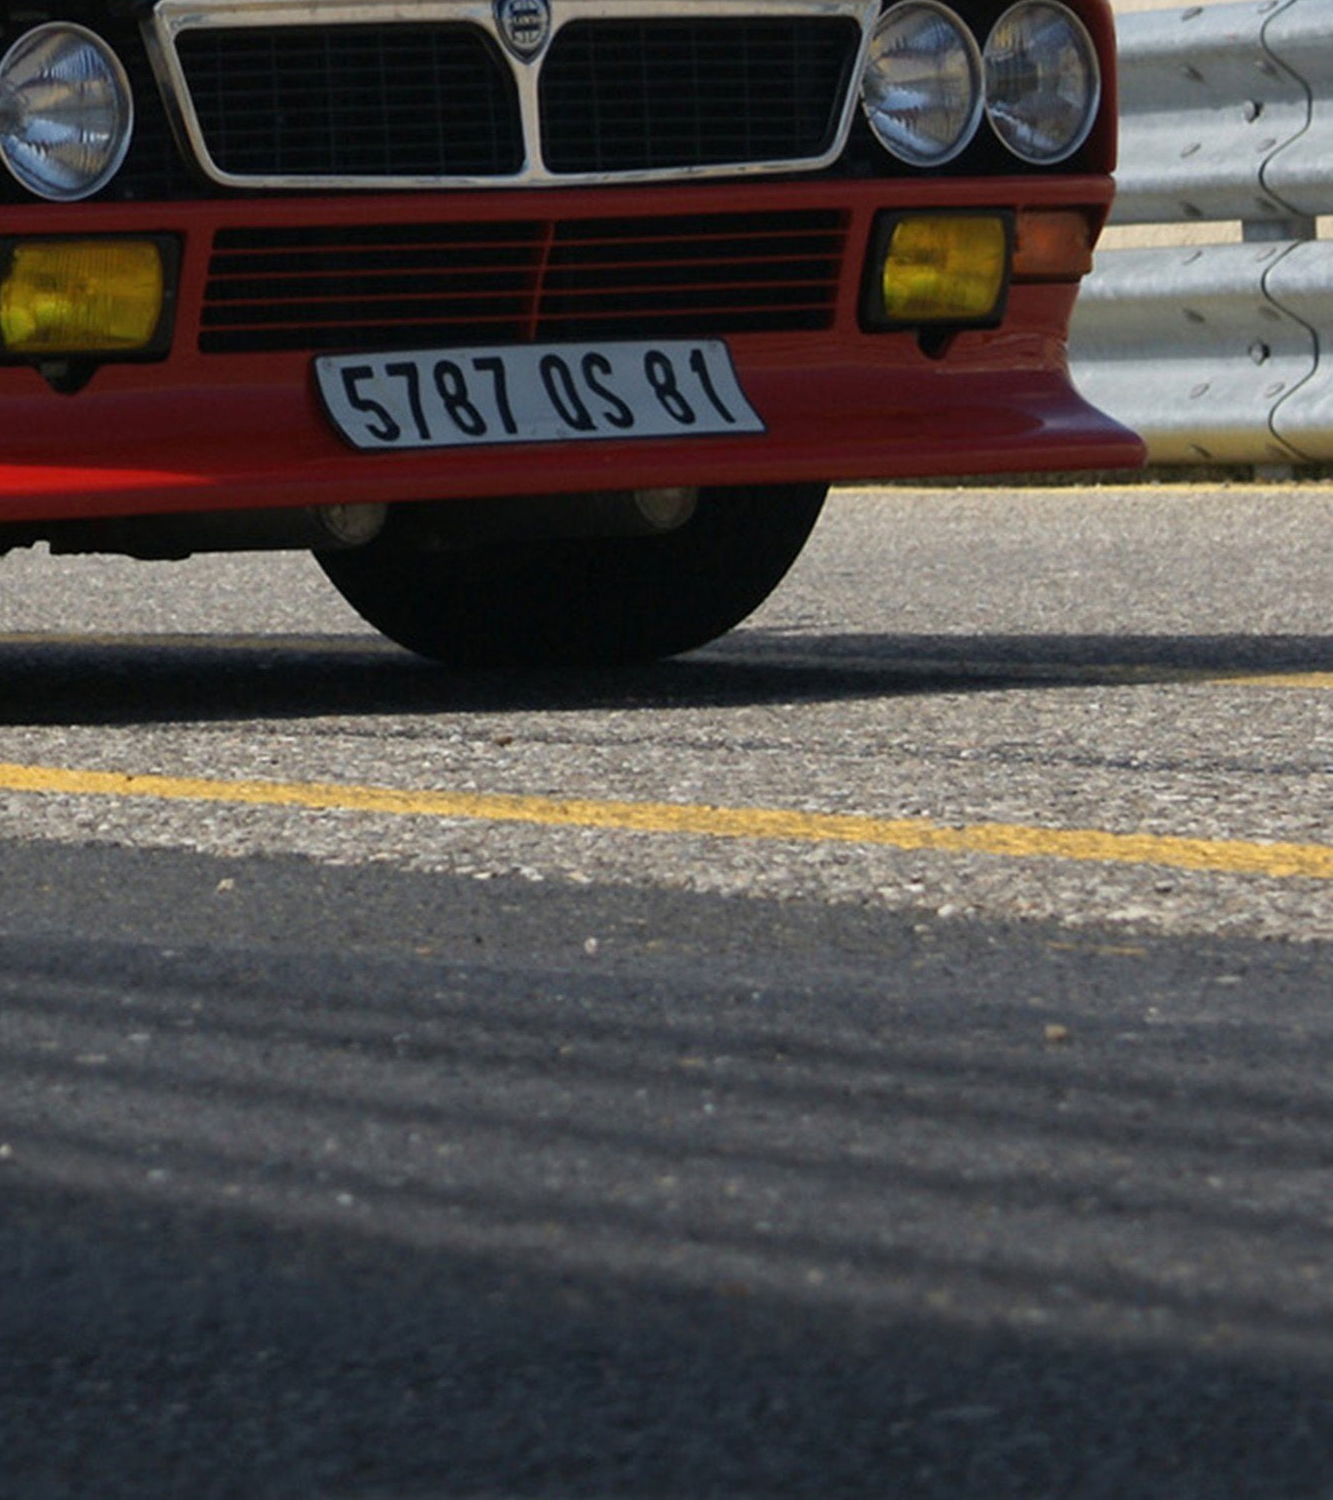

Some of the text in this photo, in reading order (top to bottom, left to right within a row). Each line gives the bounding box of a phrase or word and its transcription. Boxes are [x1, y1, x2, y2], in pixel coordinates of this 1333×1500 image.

[340, 348, 736, 442] 5787 QS 81
